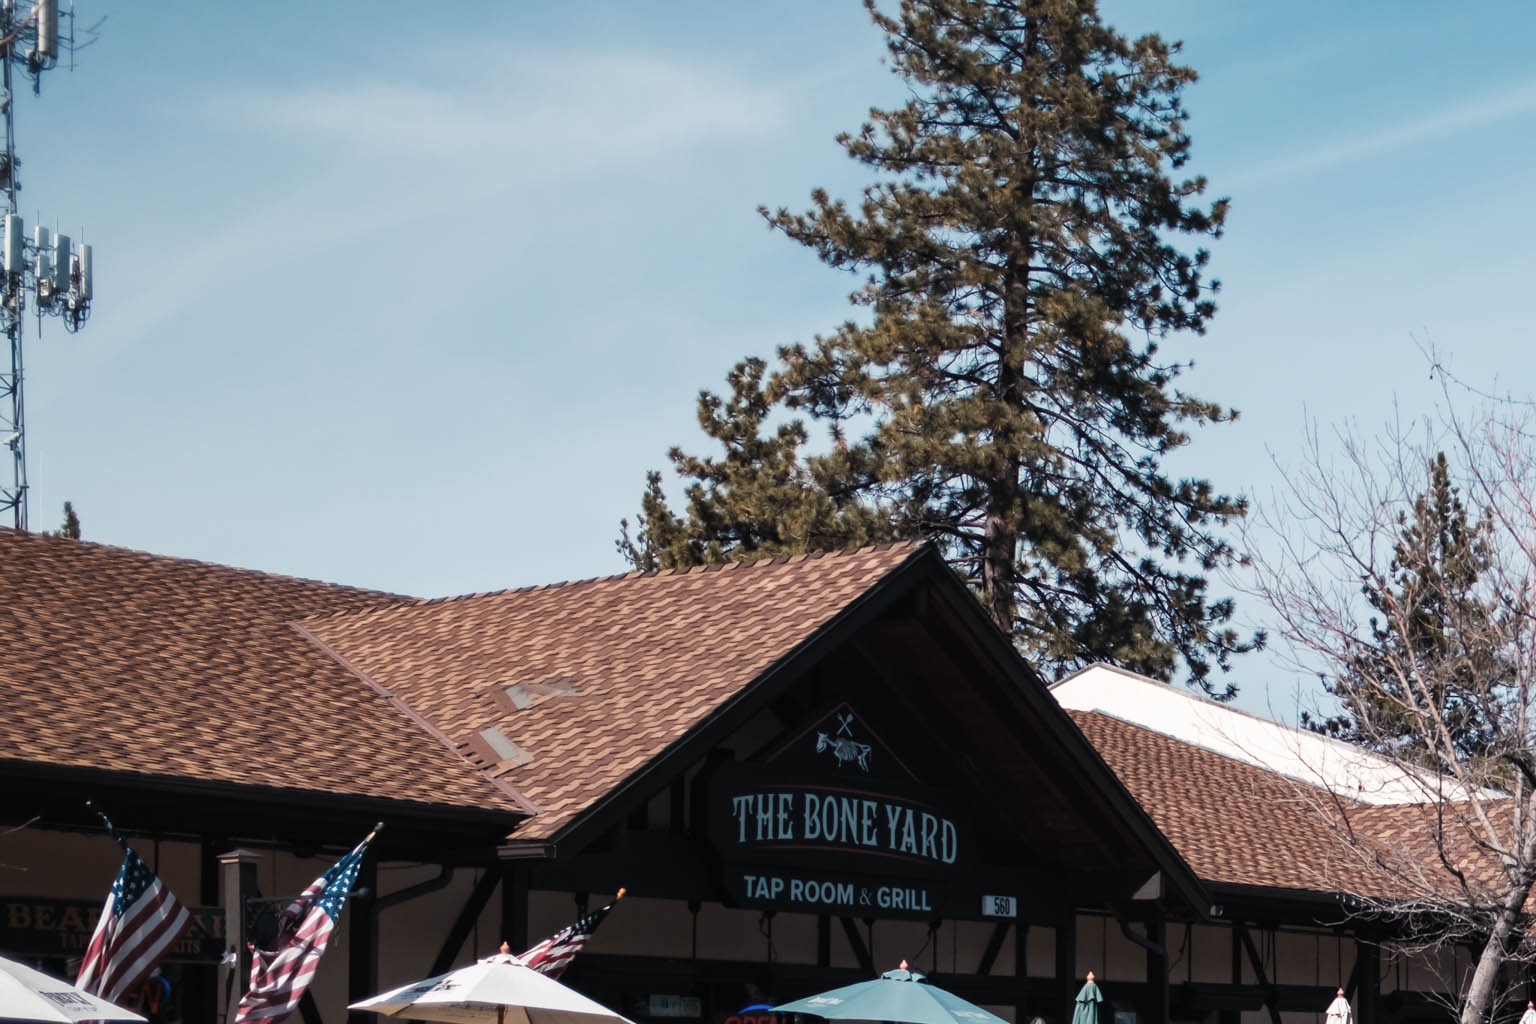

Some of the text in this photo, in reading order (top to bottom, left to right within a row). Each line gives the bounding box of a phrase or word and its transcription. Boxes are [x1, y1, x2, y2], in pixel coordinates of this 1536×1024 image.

[732, 792, 958, 865] THE BONE YARD
[744, 874, 932, 911] TAP ROOM & GRILL
[994, 897, 1011, 915] 560
